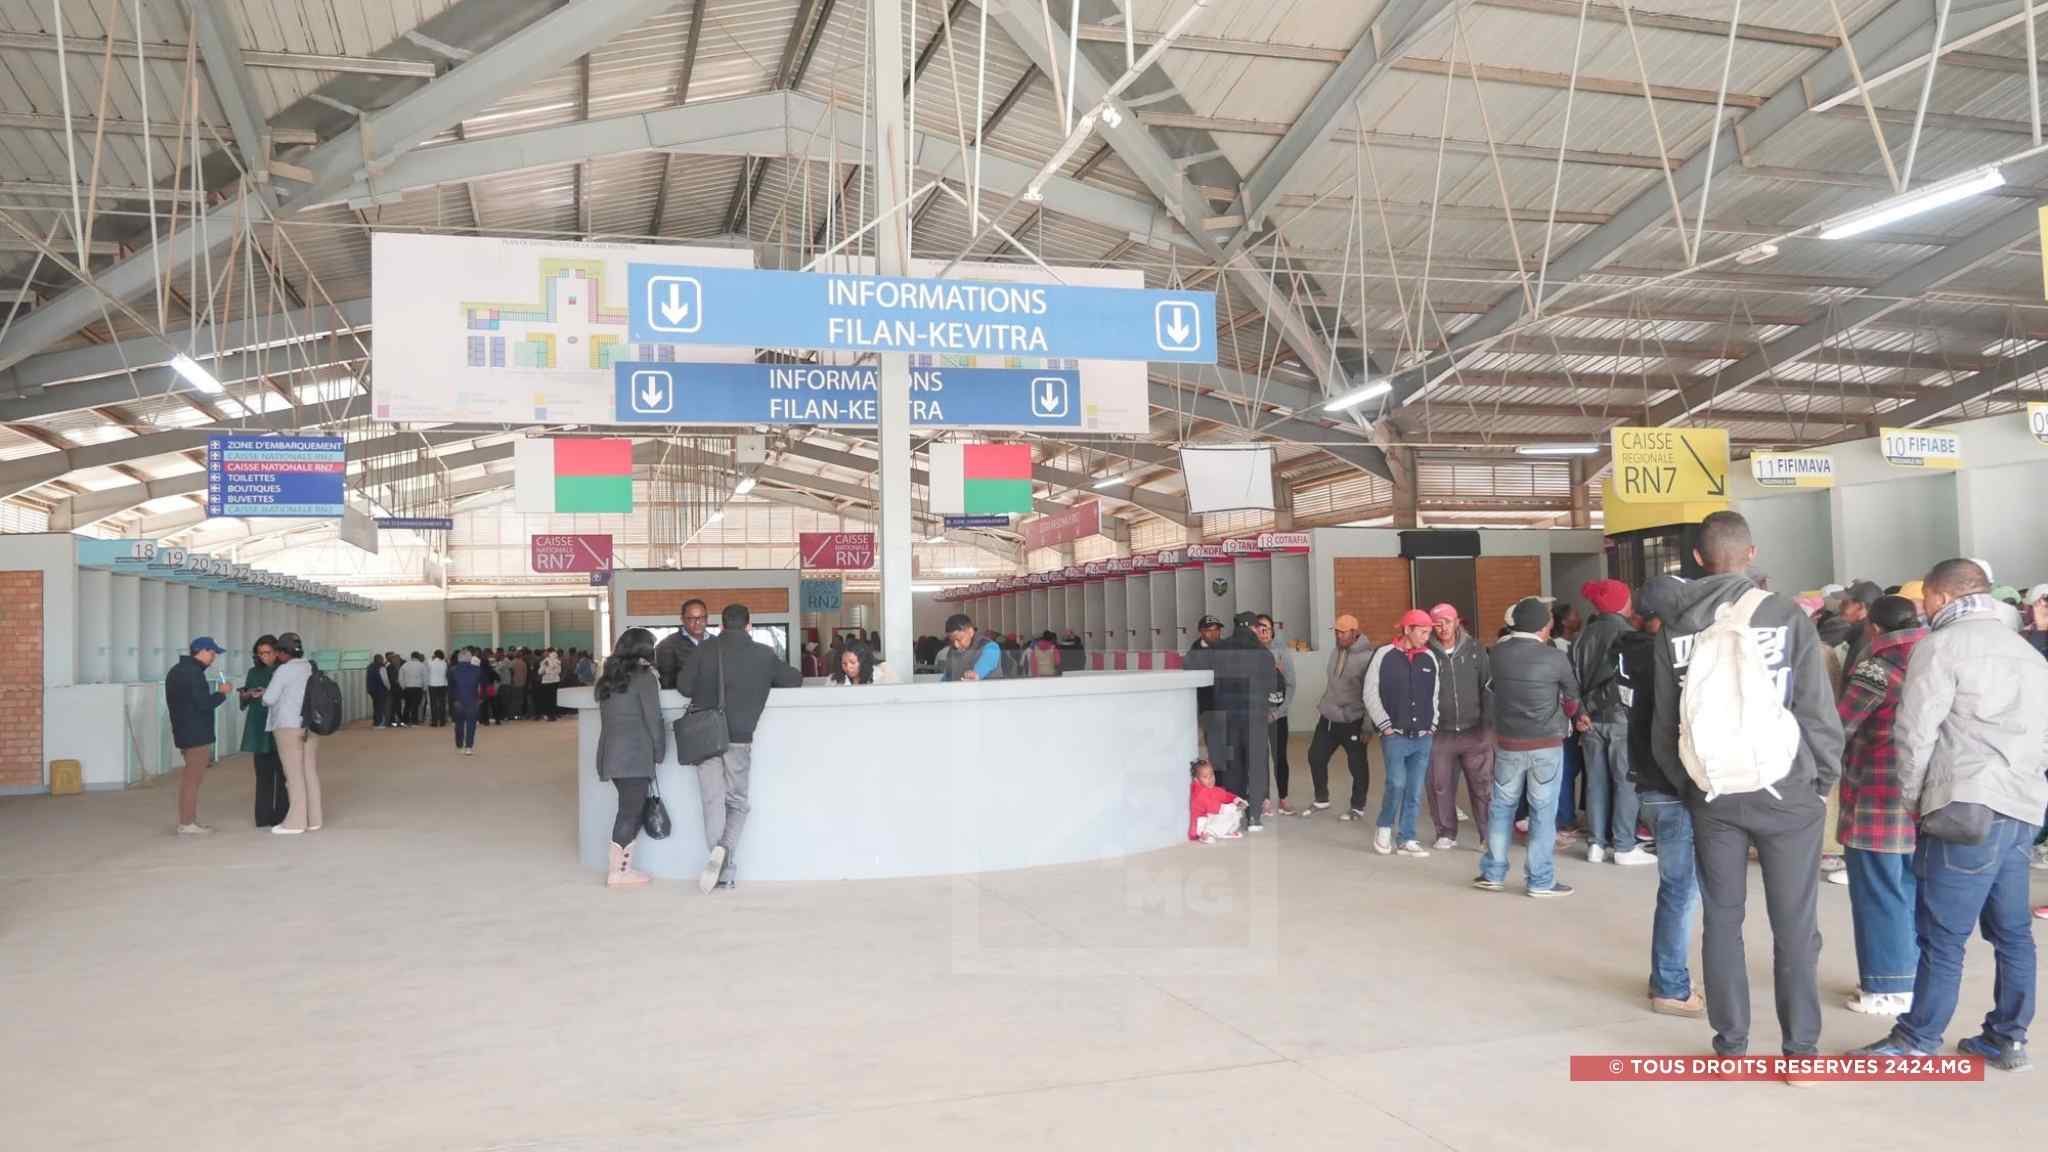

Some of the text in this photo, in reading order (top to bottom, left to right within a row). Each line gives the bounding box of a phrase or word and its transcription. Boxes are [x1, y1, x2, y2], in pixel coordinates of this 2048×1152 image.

[828, 279, 1047, 315] INFORMATIONS
[828, 318, 1048, 351] FILAN-KEVITRA
[770, 369, 943, 392] INFORMANS
[770, 399, 943, 420] FILAN-KERA
[227, 441, 253, 449] ZONE
[1622, 432, 1673, 450] CAISSE
[1887, 437, 1955, 457] 10 FIFIABE
[227, 463, 259, 471] CAISSE
[262, 463, 313, 472] NATIONALE
[1757, 459, 1831, 477] 11 FIFIMAVA
[228, 474, 275, 482] TOILETTES
[1625, 466, 1677, 494] RN7
[227, 485, 281, 493] BOUTIQUES
[227, 495, 274, 503] BUVETTES
[535, 536, 574, 546] CAISSE
[834, 534, 869, 544] CAISSE
[136, 544, 154, 560] 18
[836, 551, 871, 566] RN7
[167, 552, 183, 568] 19
[191, 558, 209, 570] 20
[536, 554, 576, 569] RN7
[214, 563, 229, 576] 21
[808, 592, 839, 608] RN2
